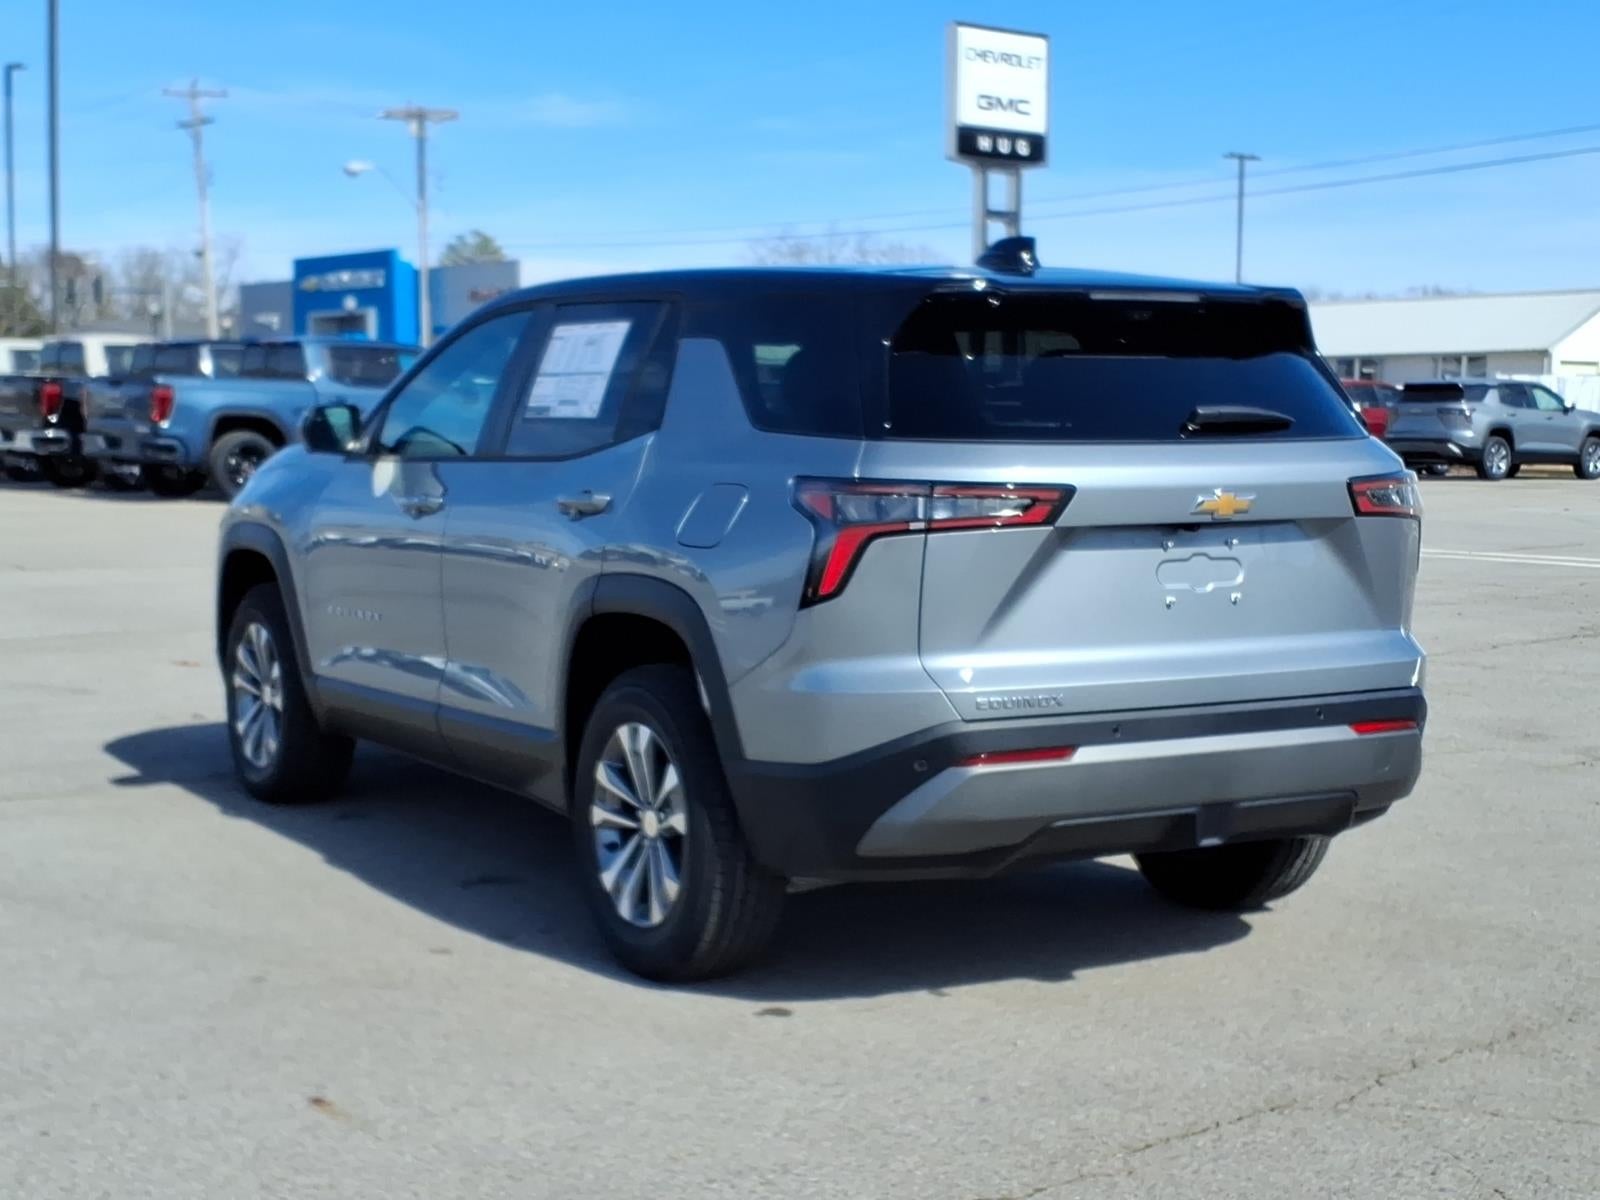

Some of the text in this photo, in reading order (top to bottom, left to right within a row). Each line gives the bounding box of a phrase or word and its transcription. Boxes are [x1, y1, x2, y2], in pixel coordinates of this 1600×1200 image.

[964, 47, 1043, 69] CHEVROLET
[976, 94, 1032, 116] GMC
[975, 135, 1032, 157] HUG
[975, 694, 1064, 711] EQUINOX
